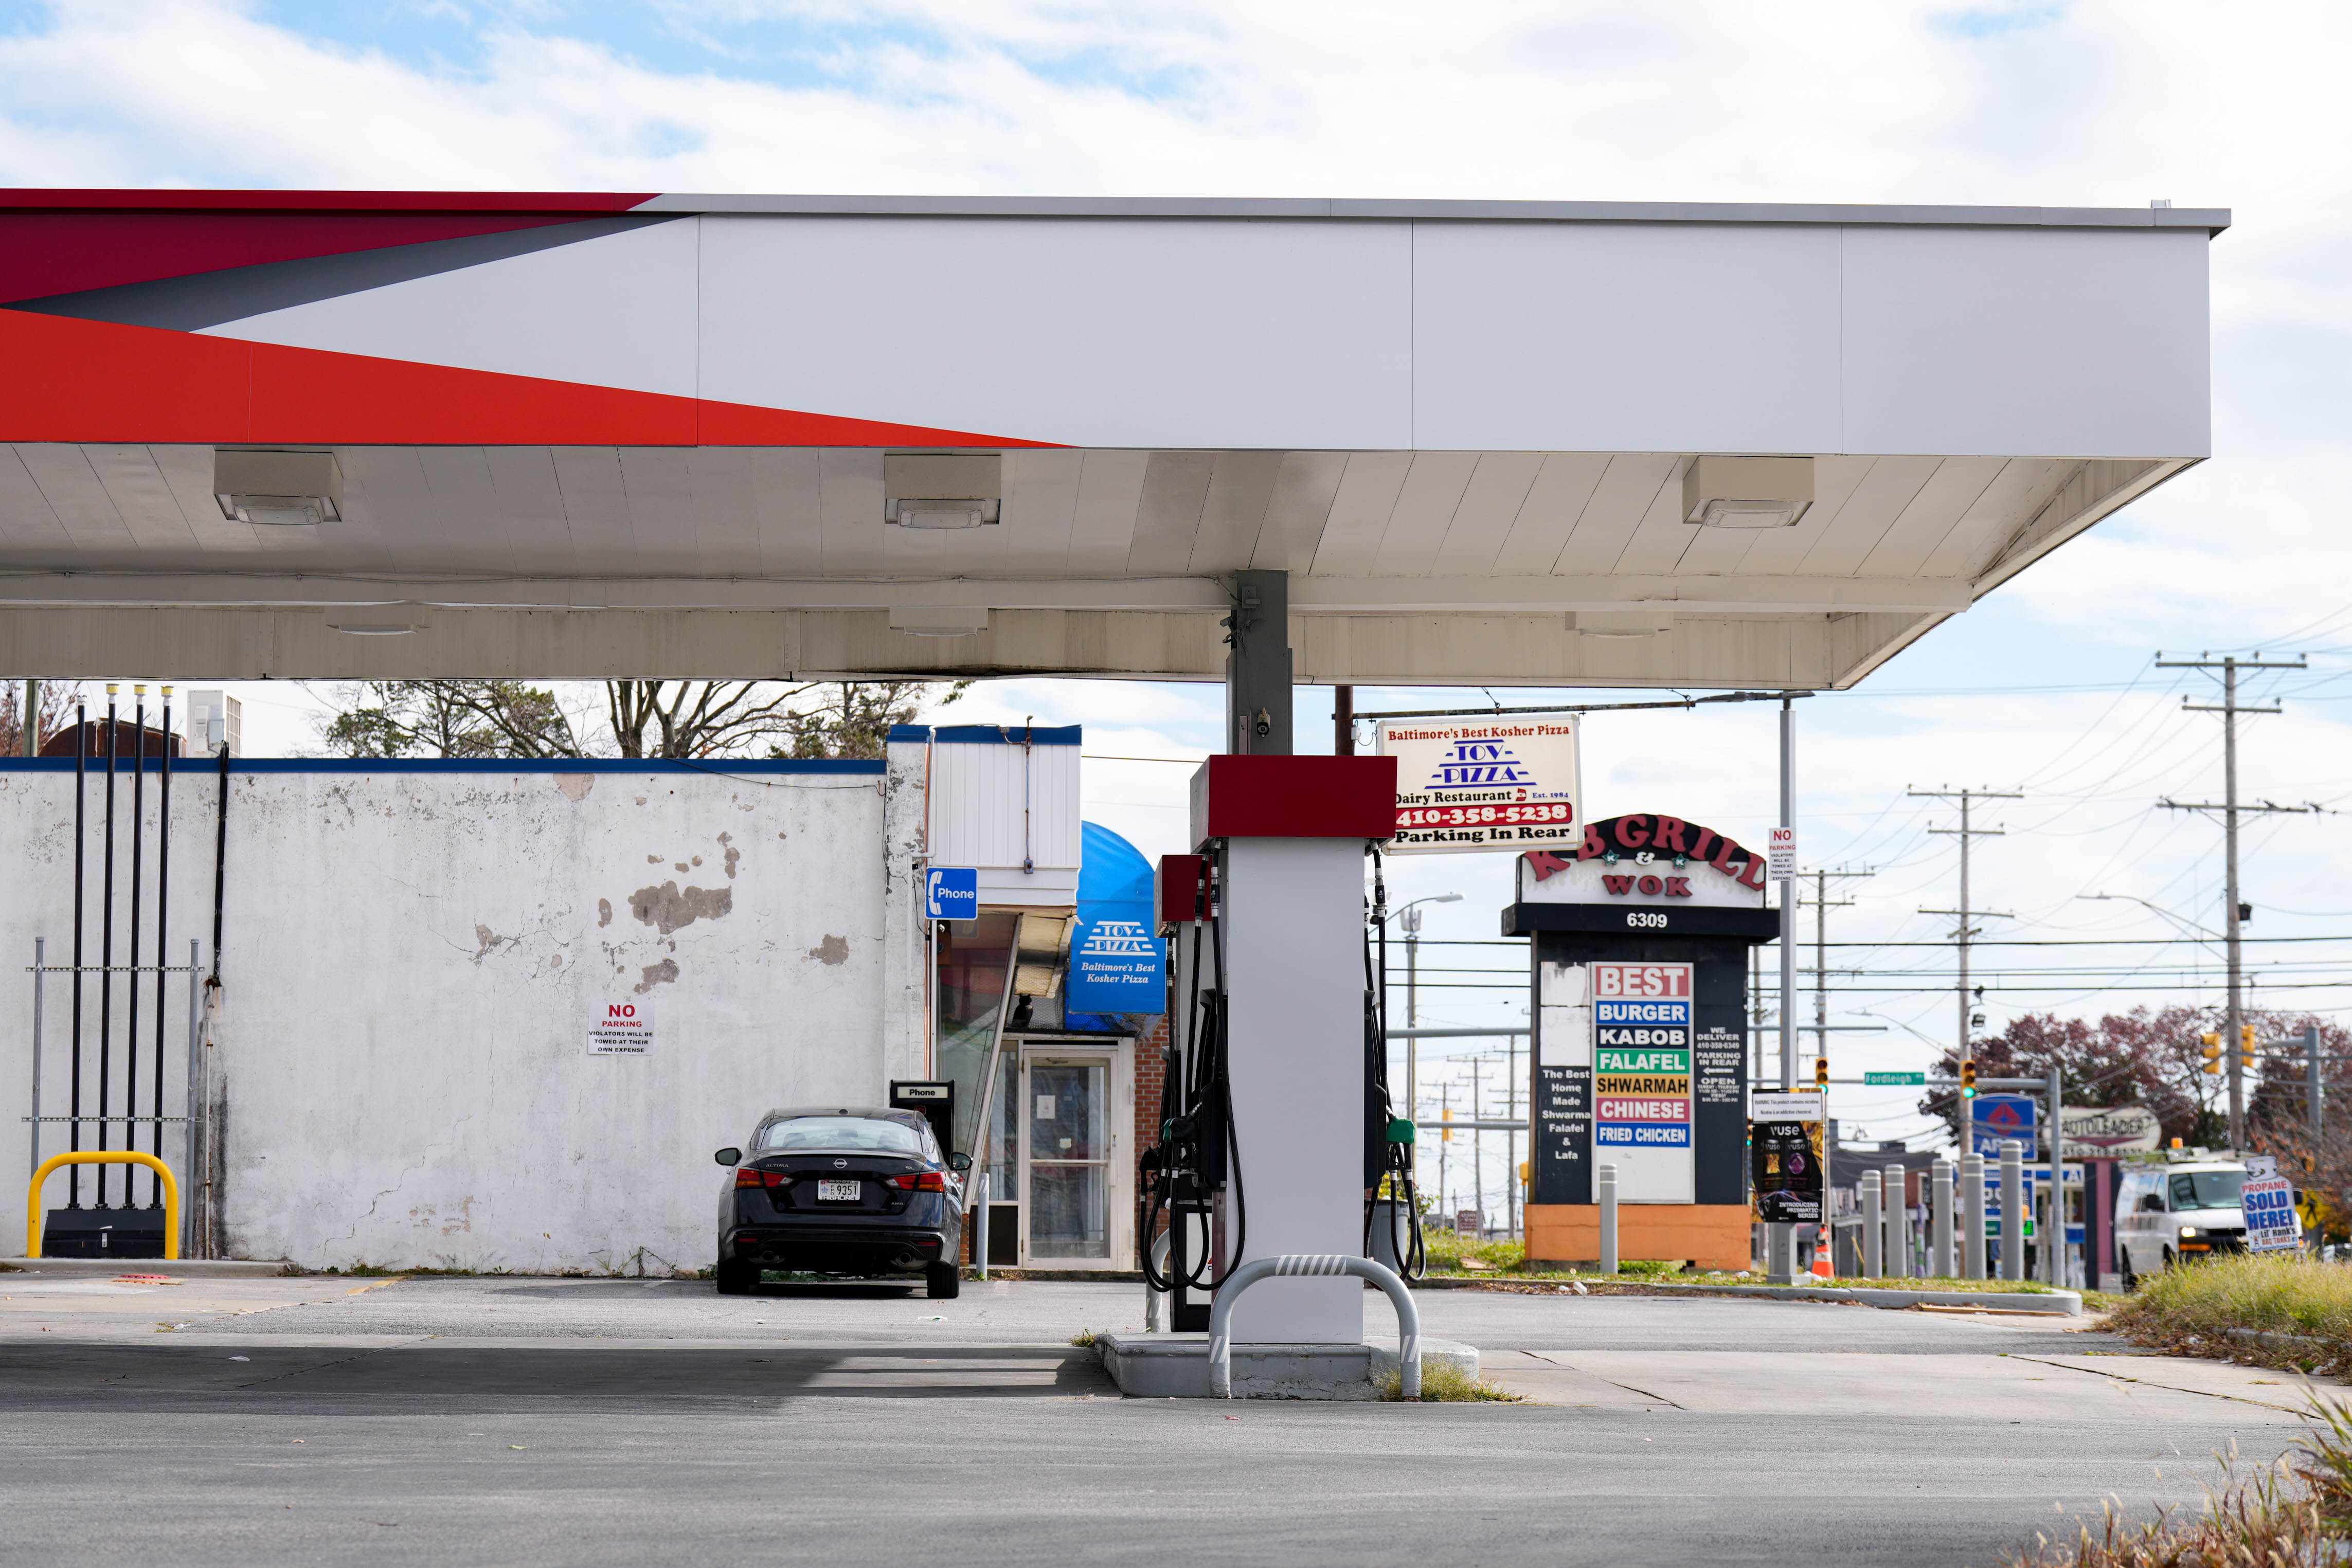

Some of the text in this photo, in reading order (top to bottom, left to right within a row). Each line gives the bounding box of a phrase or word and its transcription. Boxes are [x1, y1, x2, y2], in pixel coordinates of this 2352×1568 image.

[1388, 725, 1569, 741] Baltimore's Best Kosher Pizza
[1455, 745, 1503, 761] TOV
[1444, 766, 1518, 783] PIZZA
[1434, 790, 1512, 803] Restaurant
[1396, 804, 1567, 826] 410-358-5238
[1395, 827, 1570, 843] Parking In Rear
[1774, 830, 1791, 841] NO
[1615, 815, 1766, 892] GRILL
[1602, 875, 1692, 896] WOK
[938, 888, 975, 898] Phone
[1626, 913, 1668, 928] 6309
[1102, 926, 1135, 936] TOV
[1095, 940, 1141, 951] PIZZA
[1081, 962, 1155, 972] Baltimore's Best
[1086, 974, 1148, 983] Kosher Pizza
[1600, 967, 1685, 996] BEST
[609, 1005, 635, 1017] NO
[1599, 1004, 1686, 1021] BURGER
[1600, 1029, 1685, 1045] KABOB
[1600, 1053, 1685, 1070] FALAFEL
[1543, 1070, 1590, 1078] The Best
[1866, 1074, 1912, 1085] Fordleigh
[1551, 1083, 1582, 1092] Home
[1597, 1078, 1688, 1093] SHWARMAH
[1552, 1096, 1581, 1106] Made
[1542, 1110, 1591, 1119] Shwarma
[1601, 1101, 1685, 1119] CHINESE
[1549, 1123, 1584, 1132] Falafel
[1600, 1127, 1686, 1143] FRIED CHICKEN
[1562, 1137, 1571, 1146] &
[1555, 1150, 1578, 1160] Lafa
[837, 1185, 856, 1195] 9351
[2242, 1181, 2288, 1193] PROPANE
[2246, 1191, 2288, 1211] SOLD
[2247, 1209, 2294, 1230] HERE!
[2272, 1228, 2296, 1236] Hank's
